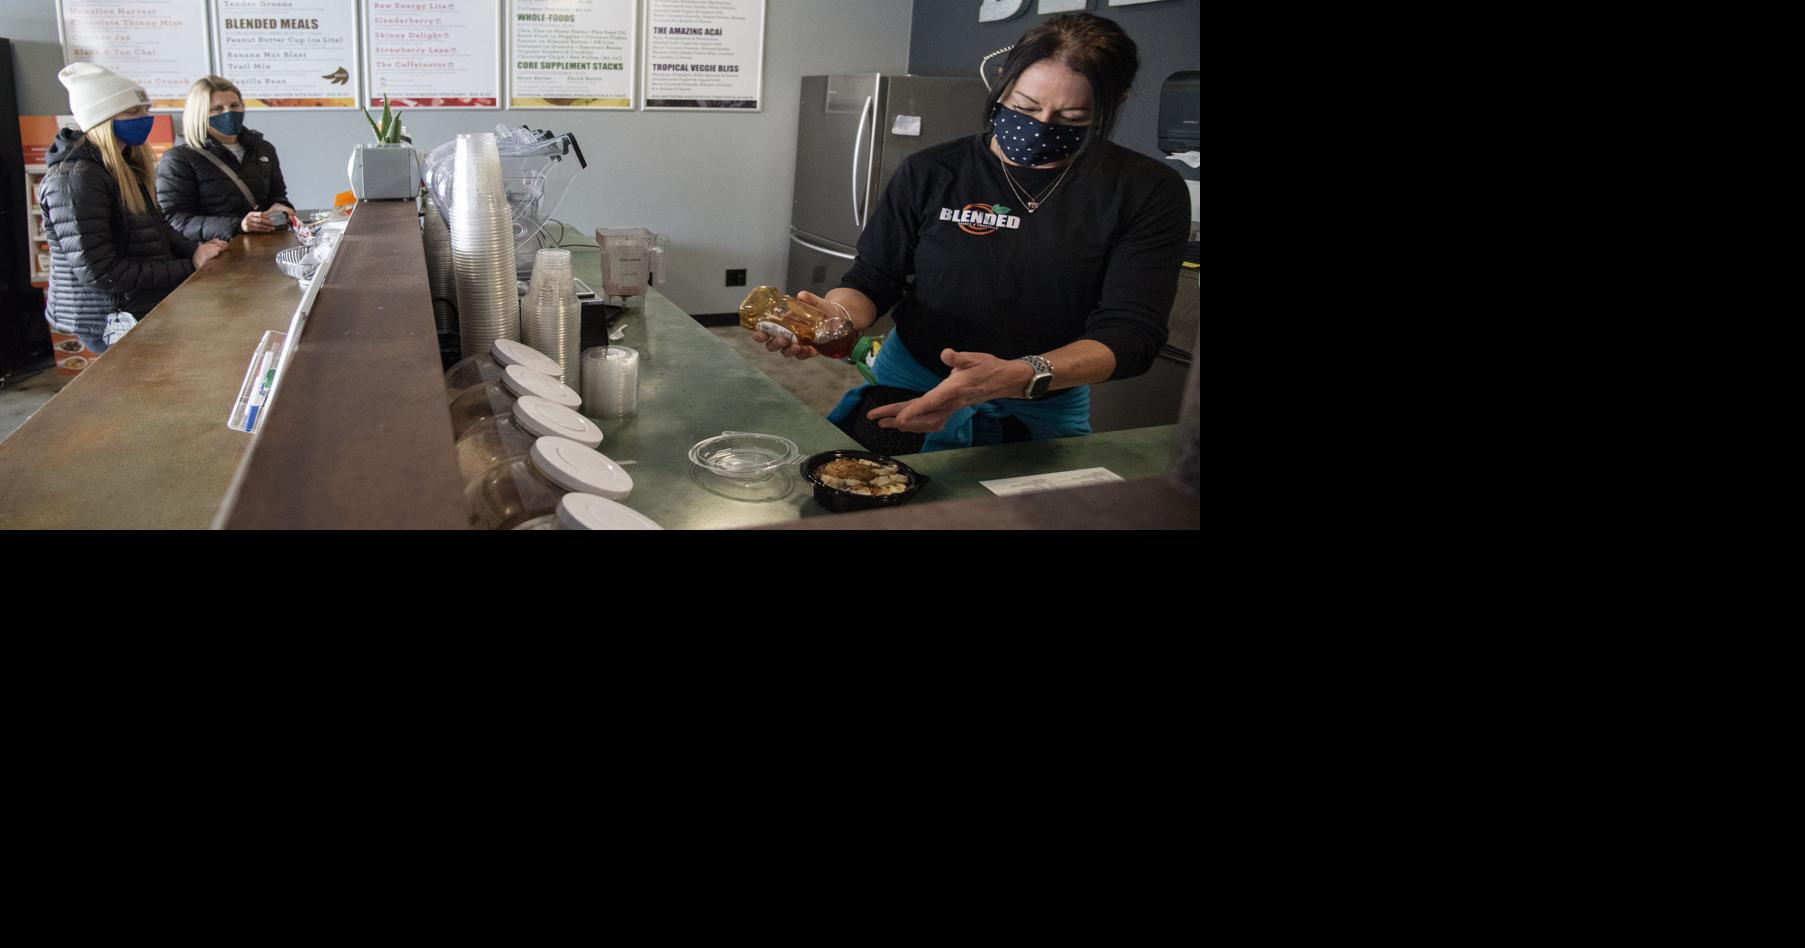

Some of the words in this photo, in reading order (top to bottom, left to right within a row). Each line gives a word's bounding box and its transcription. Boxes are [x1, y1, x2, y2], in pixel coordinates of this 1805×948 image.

[395, 2, 426, 11] Energy
[517, 13, 576, 23] WHOLE-FOODS
[225, 18, 278, 30] BLENDED
[280, 18, 319, 30] MEALS
[408, 32, 442, 40] Delight
[653, 26, 668, 35] THE
[669, 27, 704, 36] AMAZING
[517, 61, 541, 70] CORE
[540, 62, 591, 71] SUPPLEMENT
[592, 63, 624, 71] STACKS
[652, 63, 688, 72] TROPICAL
[690, 64, 716, 72] VEGGIE
[718, 65, 739, 73] BLISS
[939, 207, 1021, 229] BLENDED
